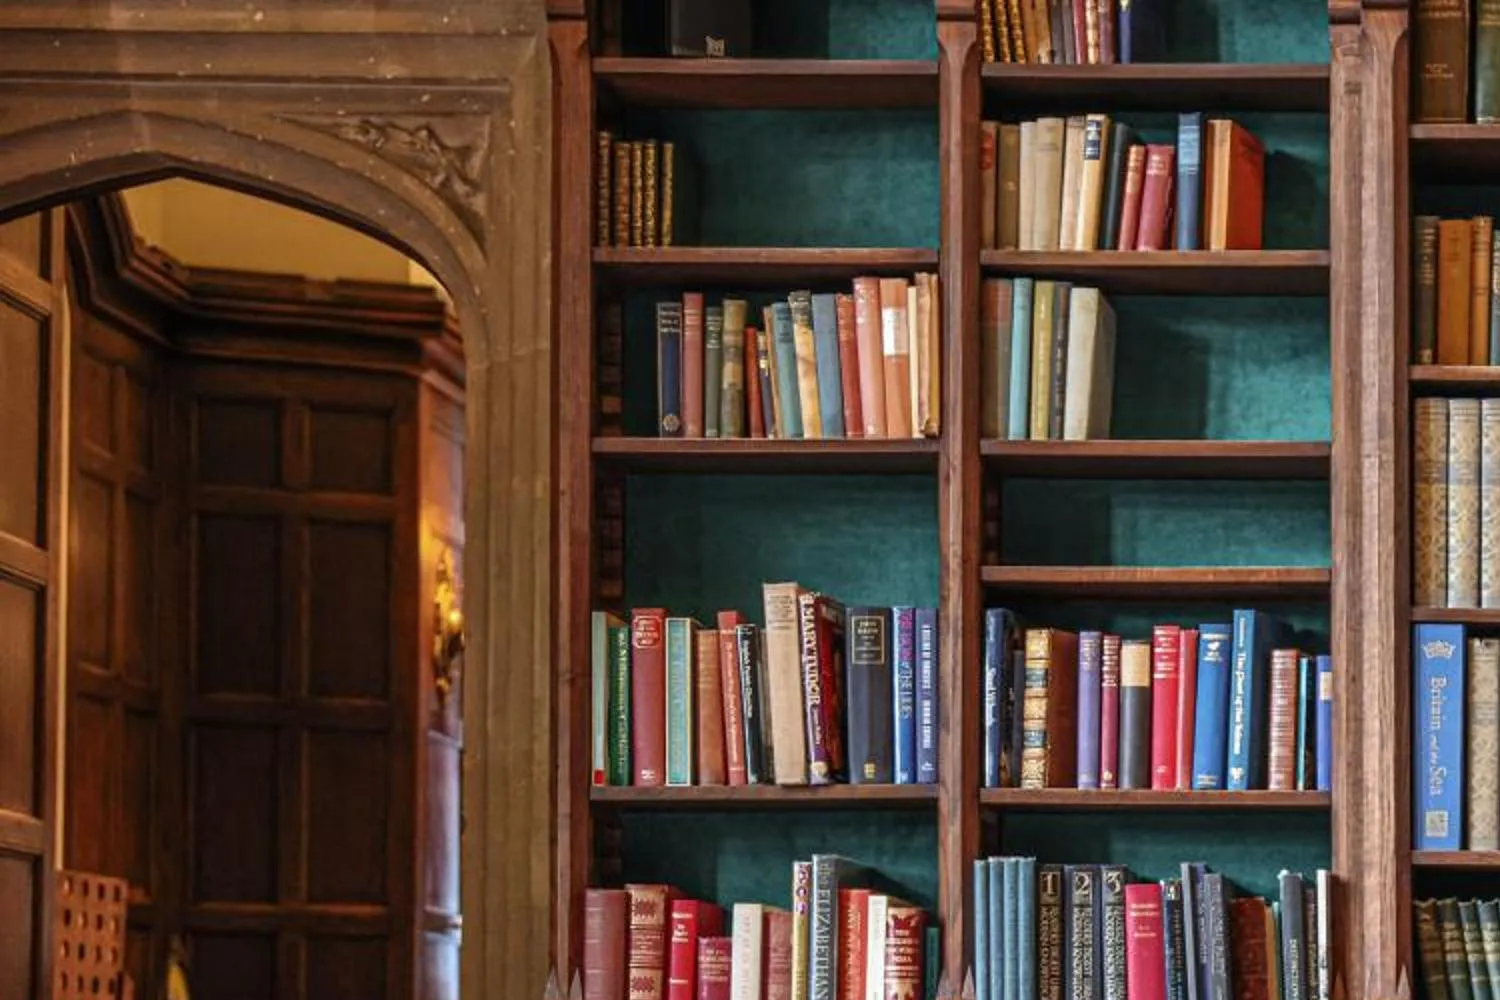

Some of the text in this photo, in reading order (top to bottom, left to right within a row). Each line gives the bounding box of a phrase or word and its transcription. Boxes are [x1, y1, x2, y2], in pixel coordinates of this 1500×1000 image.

[802, 652, 821, 705] TUDOR
[1430, 676, 1447, 730] Britain
[1429, 766, 1447, 796] Sea
[1076, 872, 1091, 895] 2
[1106, 871, 1121, 894] 3
[814, 889, 832, 1000] ELIZABETHAN
